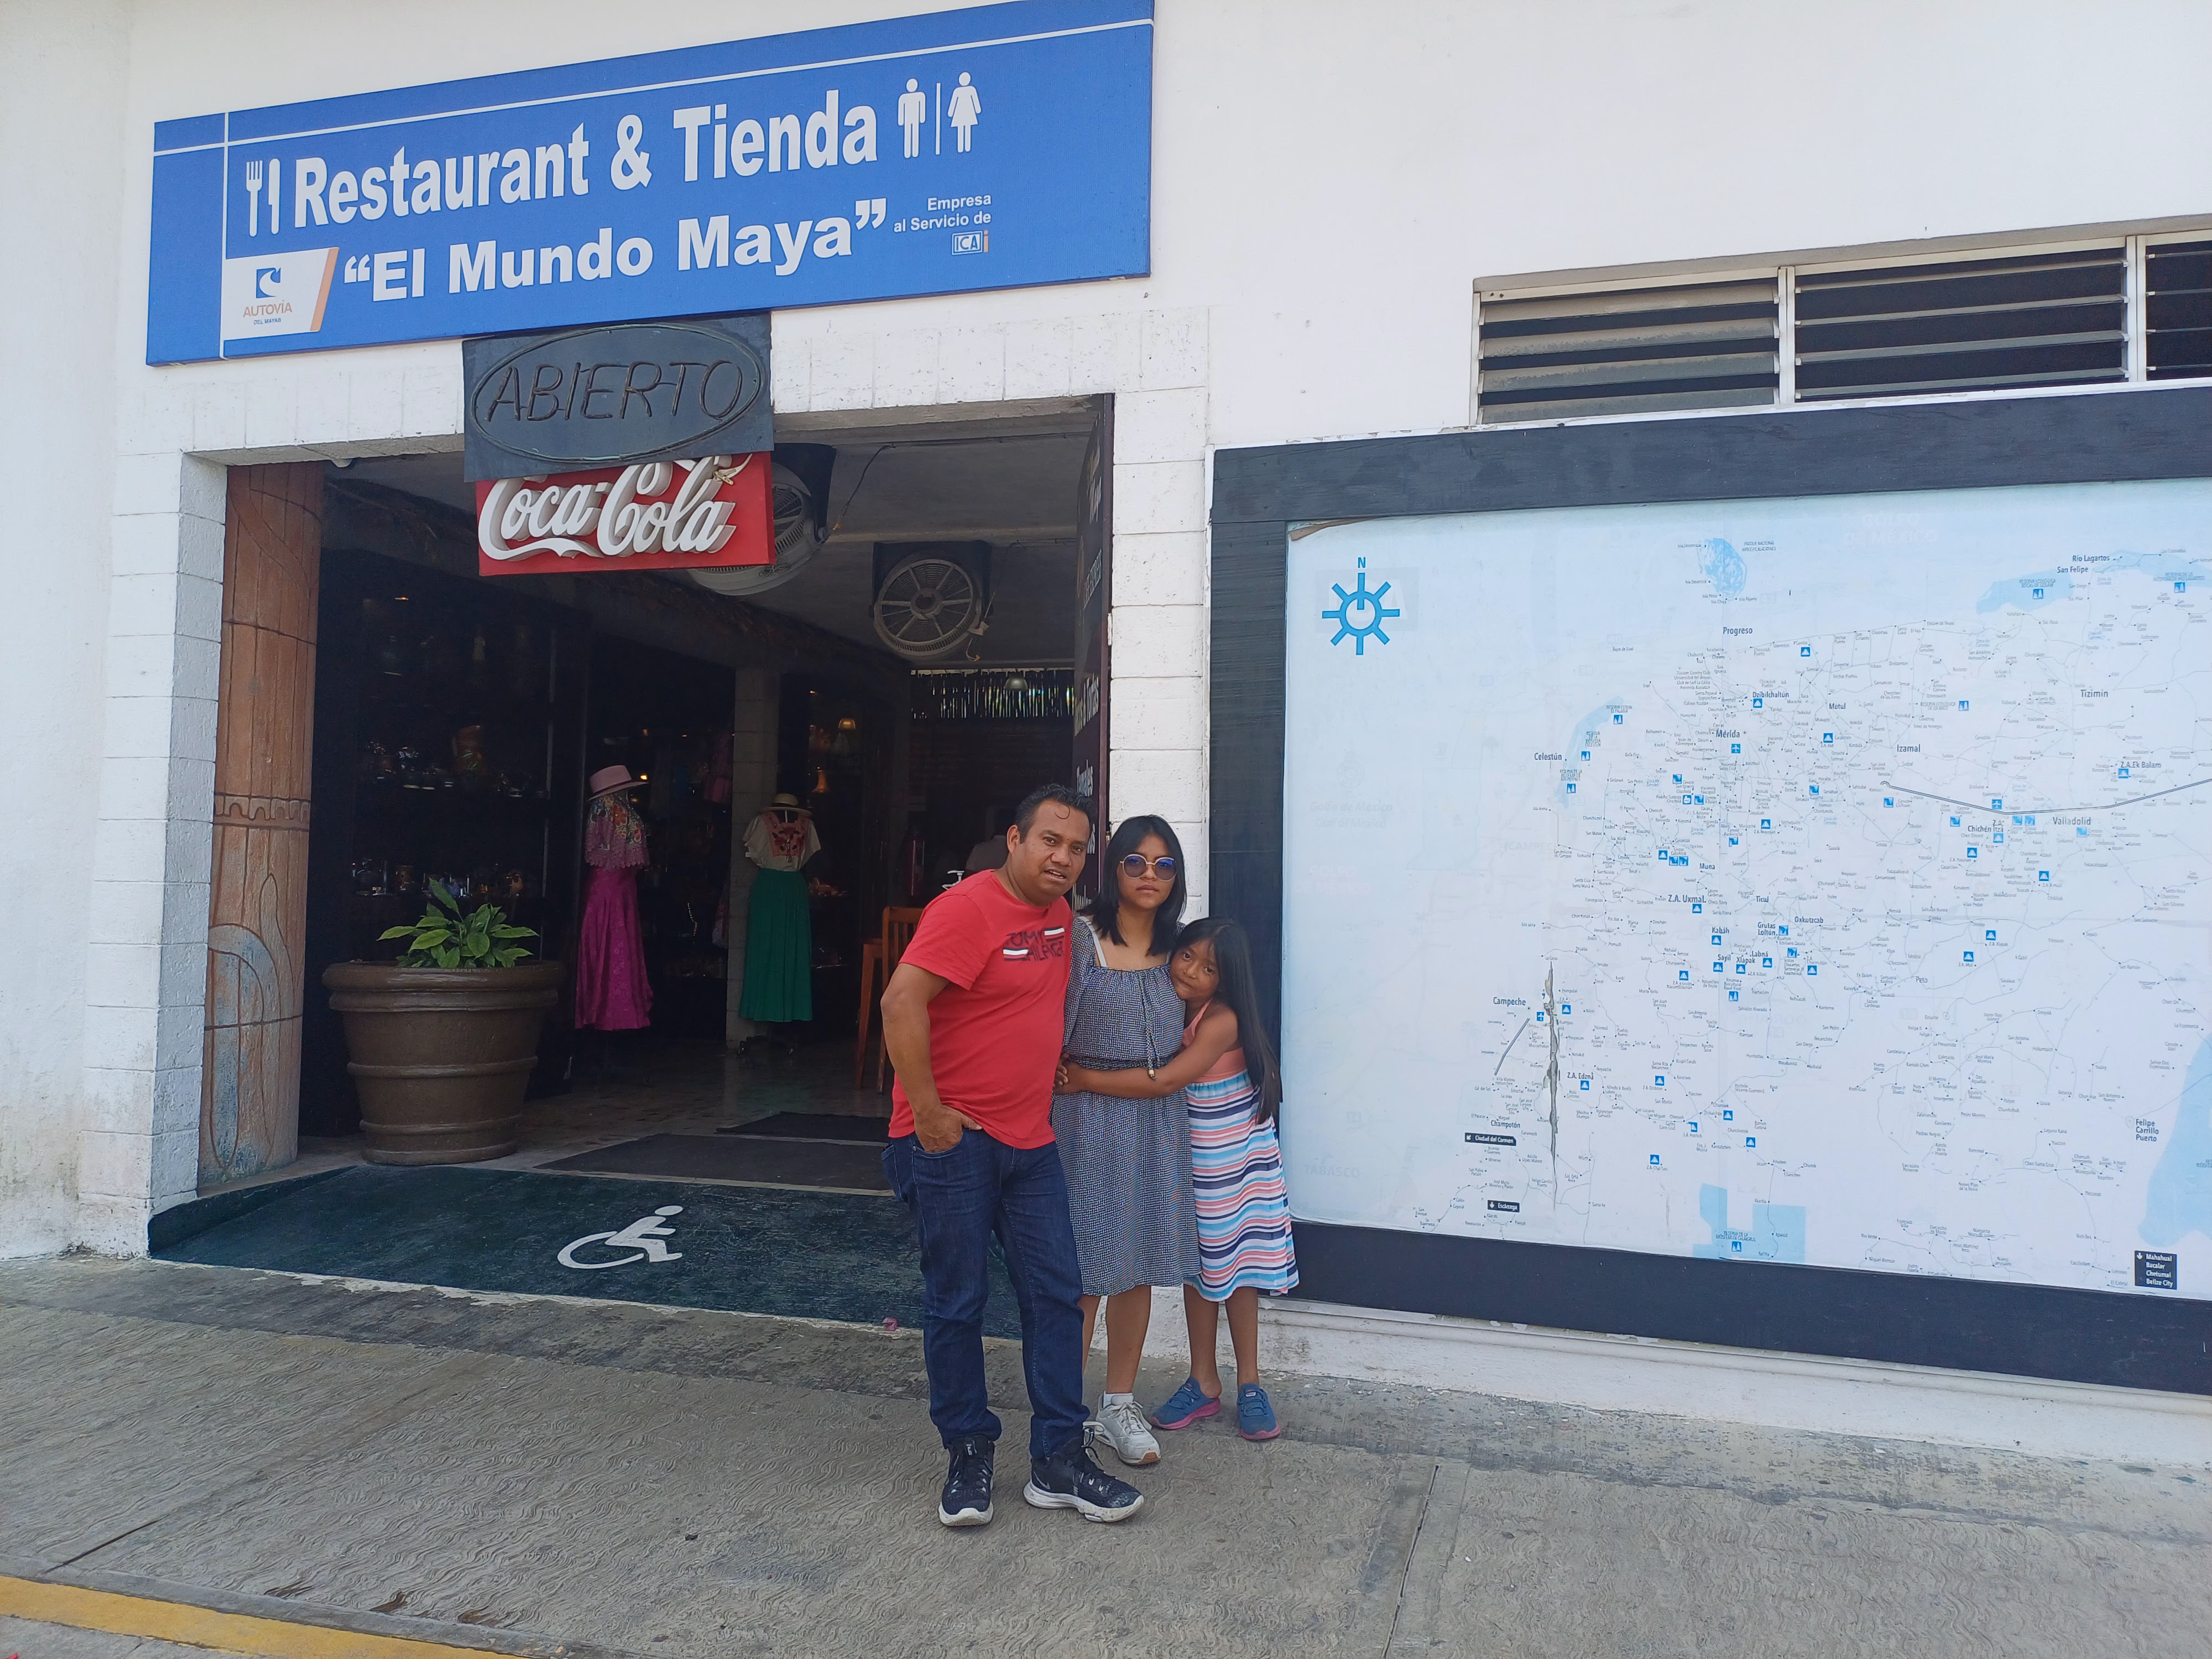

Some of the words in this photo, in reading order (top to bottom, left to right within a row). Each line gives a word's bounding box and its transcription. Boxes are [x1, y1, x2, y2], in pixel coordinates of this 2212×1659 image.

[294, 122, 589, 229] Restaurant
[610, 114, 653, 191] &
[674, 90, 877, 181] Tienda
[927, 195, 992, 211] Empresa
[894, 219, 906, 232] al
[911, 213, 969, 231] Servicio
[974, 211, 992, 224] de
[448, 228, 653, 294] Mundo
[243, 300, 293, 317] AUTOVÍA
[484, 359, 743, 422] ABIERTO
[478, 454, 737, 560] Coca-Cola
[1358, 556, 1366, 568] N
[1723, 627, 1753, 636] Progreso
[1086, 672, 1099, 722] Tortas
[1534, 752, 1562, 760] Celestún
[1897, 744, 1921, 753] Izamal
[1076, 759, 1093, 797] Tamales
[1493, 997, 1526, 1006] Campeche
[1491, 1120, 1520, 1129] Champotón
[2163, 1279, 2173, 1287] City
